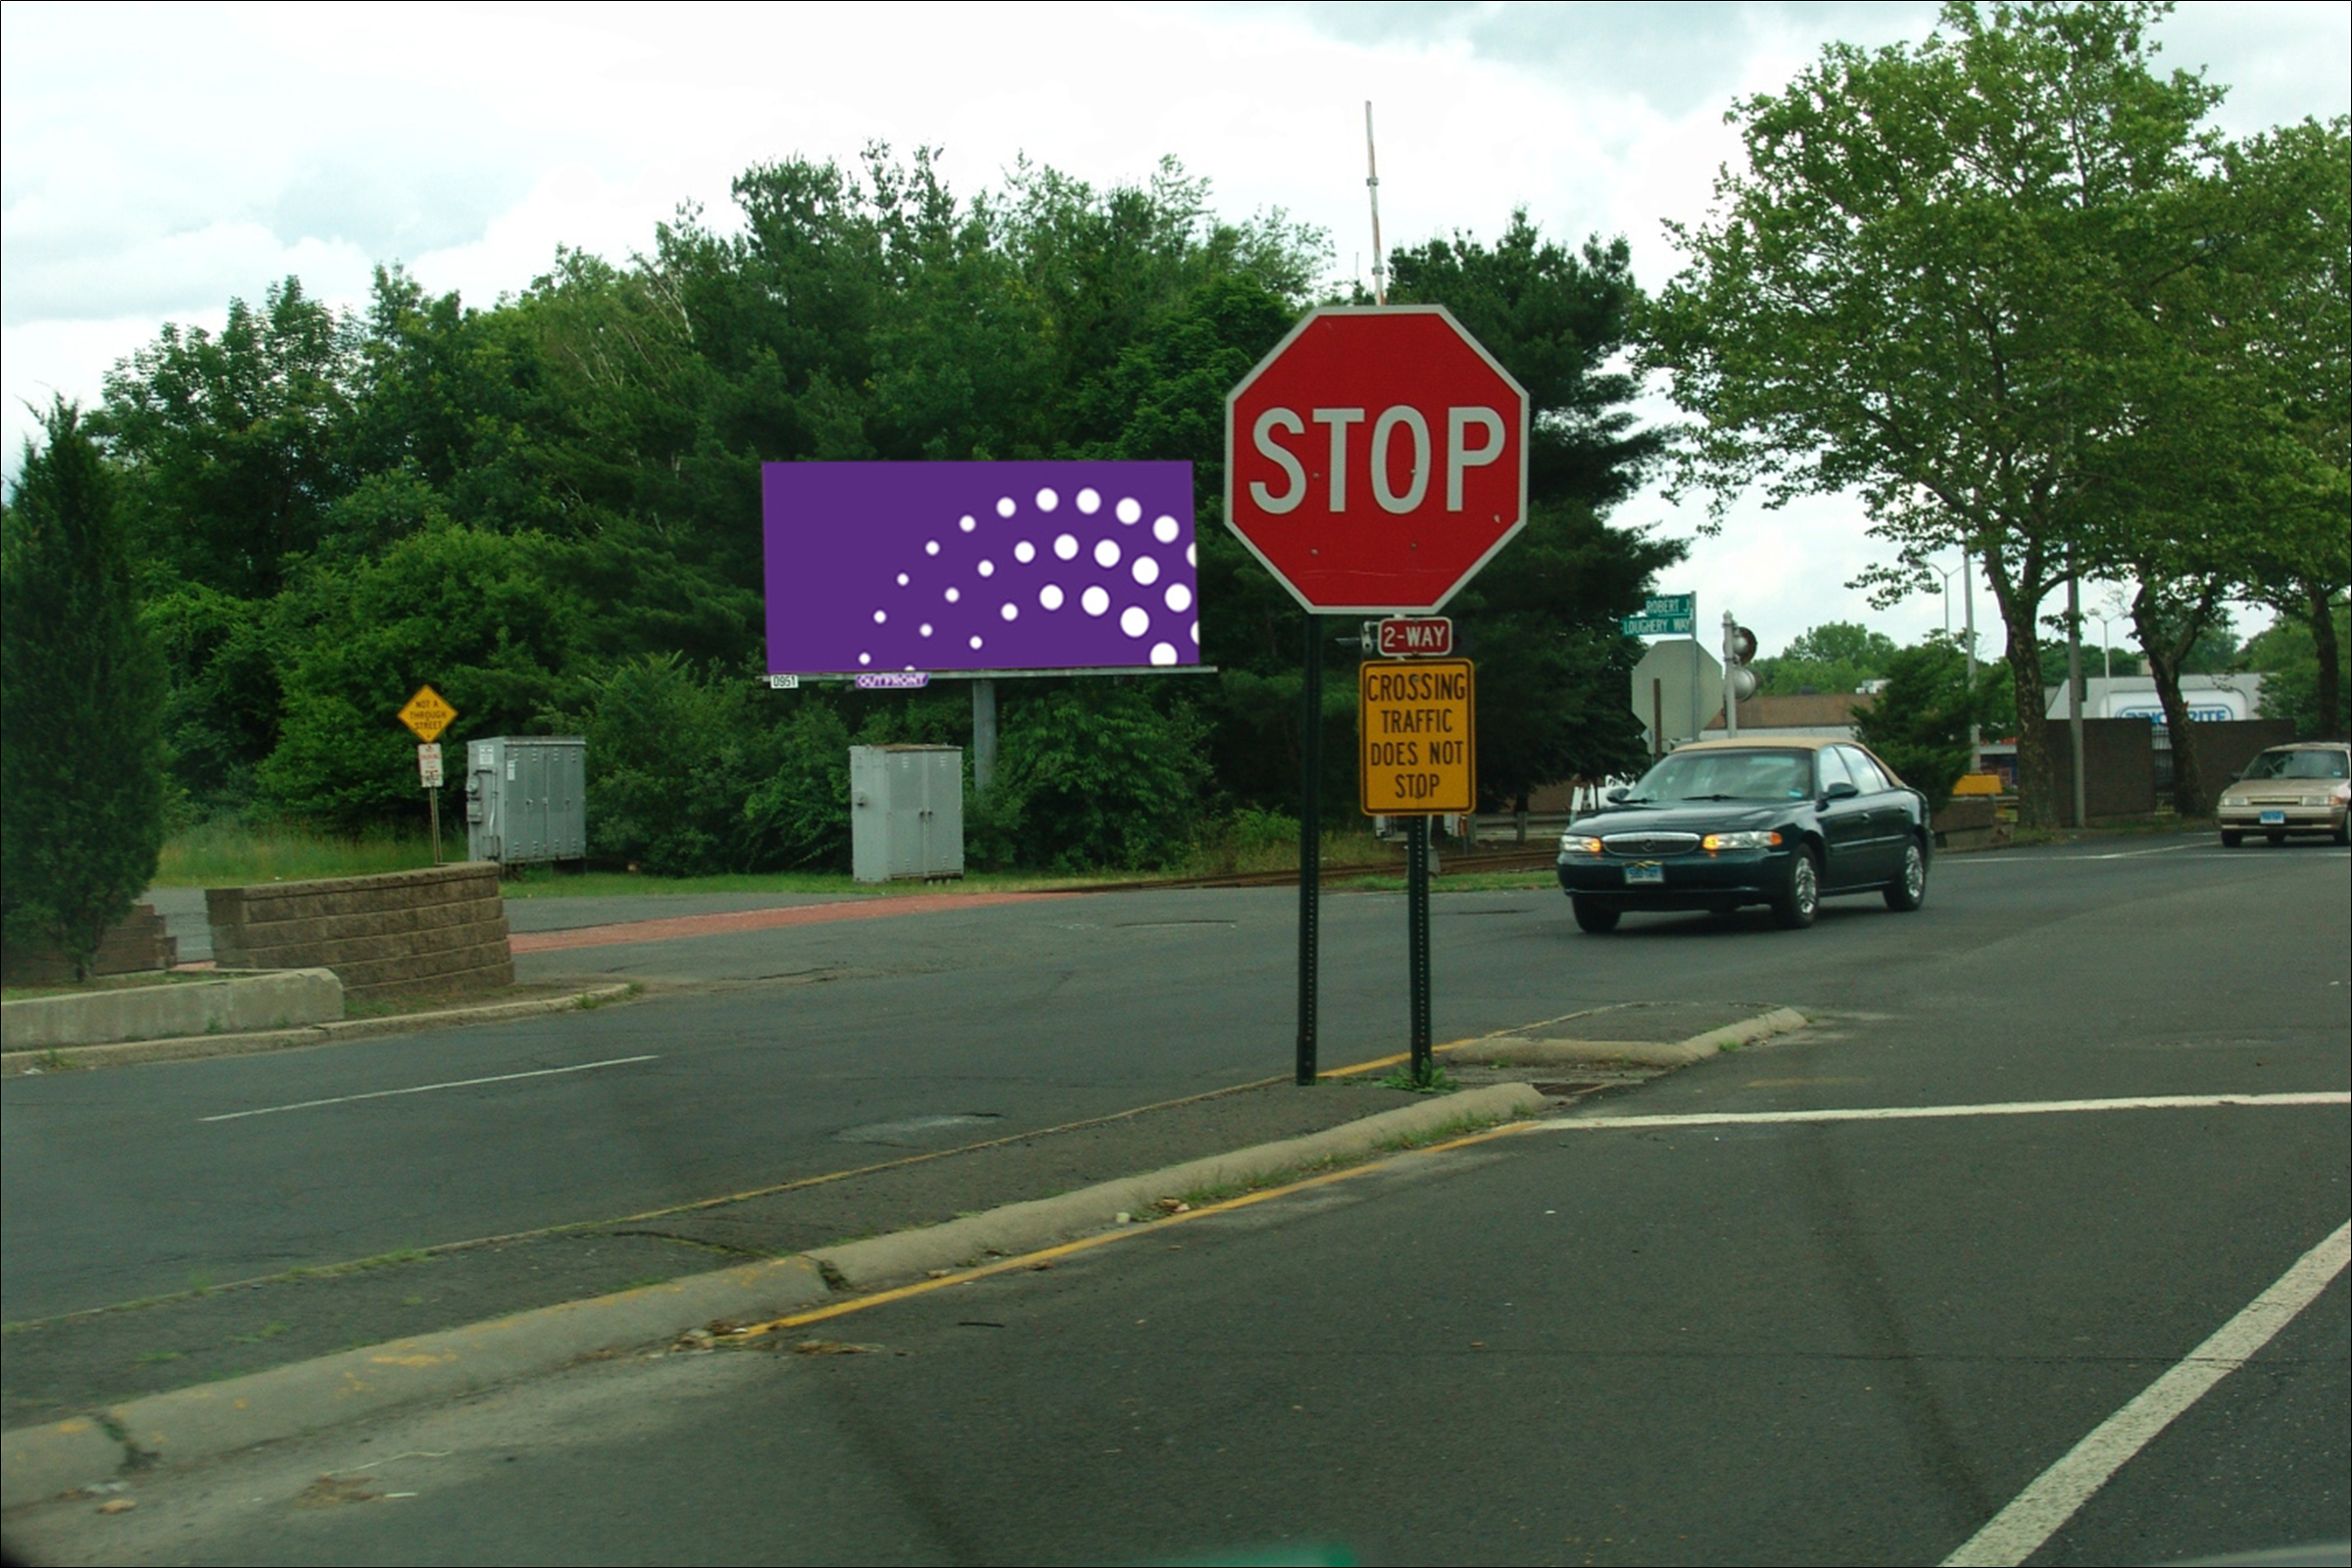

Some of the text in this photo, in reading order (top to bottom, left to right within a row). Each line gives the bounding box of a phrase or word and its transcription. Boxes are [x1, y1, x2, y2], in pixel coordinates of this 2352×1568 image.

[1250, 405, 1506, 514] STOP
[1645, 599, 1680, 613] ROBERT
[1624, 618, 1690, 634] LOUGHERY WAY
[1383, 625, 1446, 648] 2-WAY
[773, 675, 797, 687] 0951
[1367, 673, 1466, 703] CROSSING
[416, 700, 430, 709] NOT
[410, 710, 447, 719] THROUGH
[1382, 709, 1453, 733] TRAFFIC
[415, 720, 442, 730] STREET
[1372, 741, 1464, 766] DOES NOT
[1396, 773, 1441, 799] STOP
